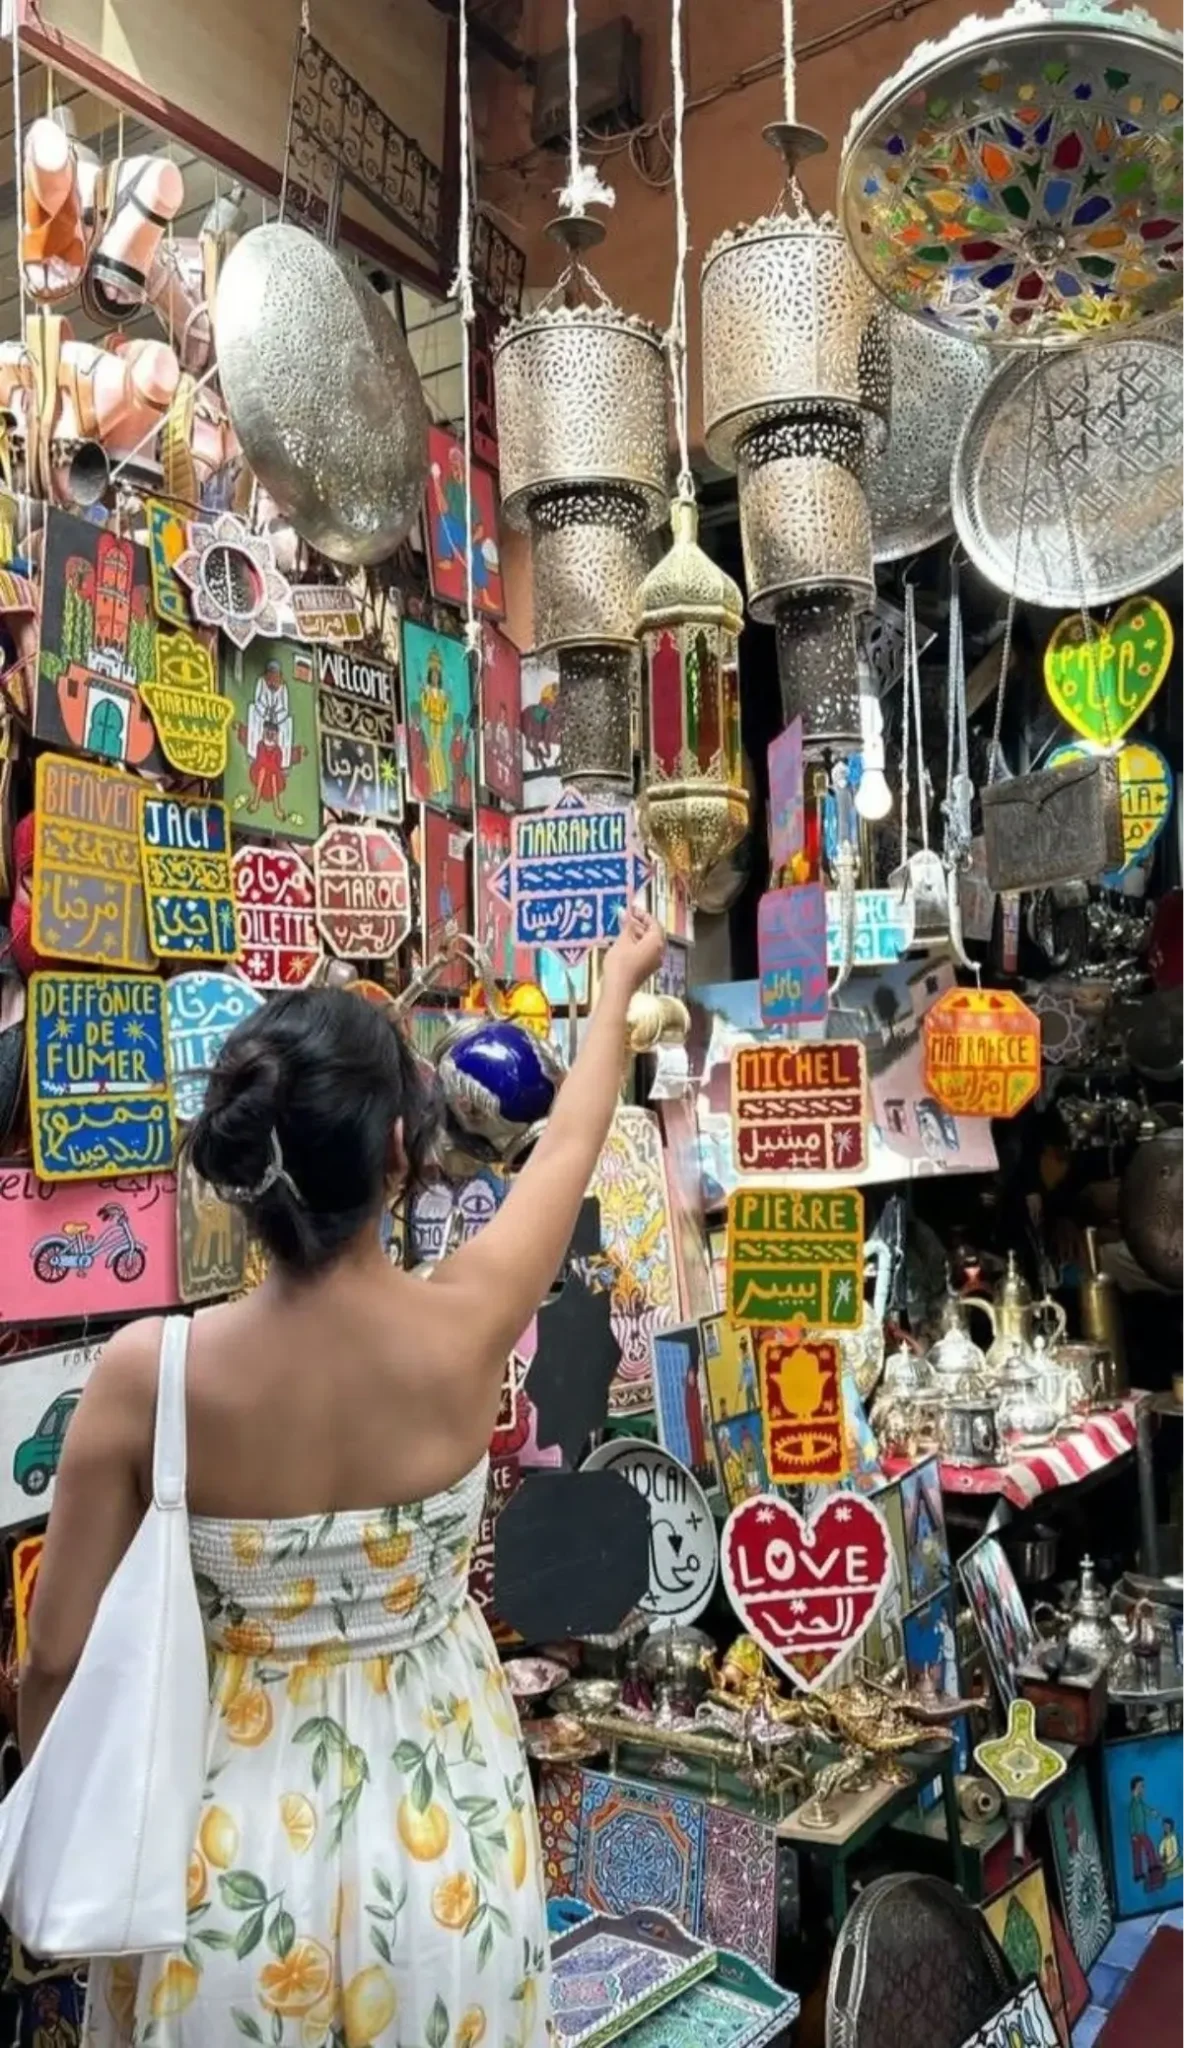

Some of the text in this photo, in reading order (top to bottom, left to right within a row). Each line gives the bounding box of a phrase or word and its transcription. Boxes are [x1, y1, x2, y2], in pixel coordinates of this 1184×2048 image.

[318, 648, 391, 705] WELCOME
[323, 879, 404, 908] MAROC
[238, 911, 316, 947] OILETTE
[86, 1021, 115, 1046] DE
[46, 1043, 149, 1082] FUMER
[740, 1050, 850, 1089] MICHEL
[741, 1198, 847, 1231] PIERRE
[738, 1538, 869, 1588] LOVE
